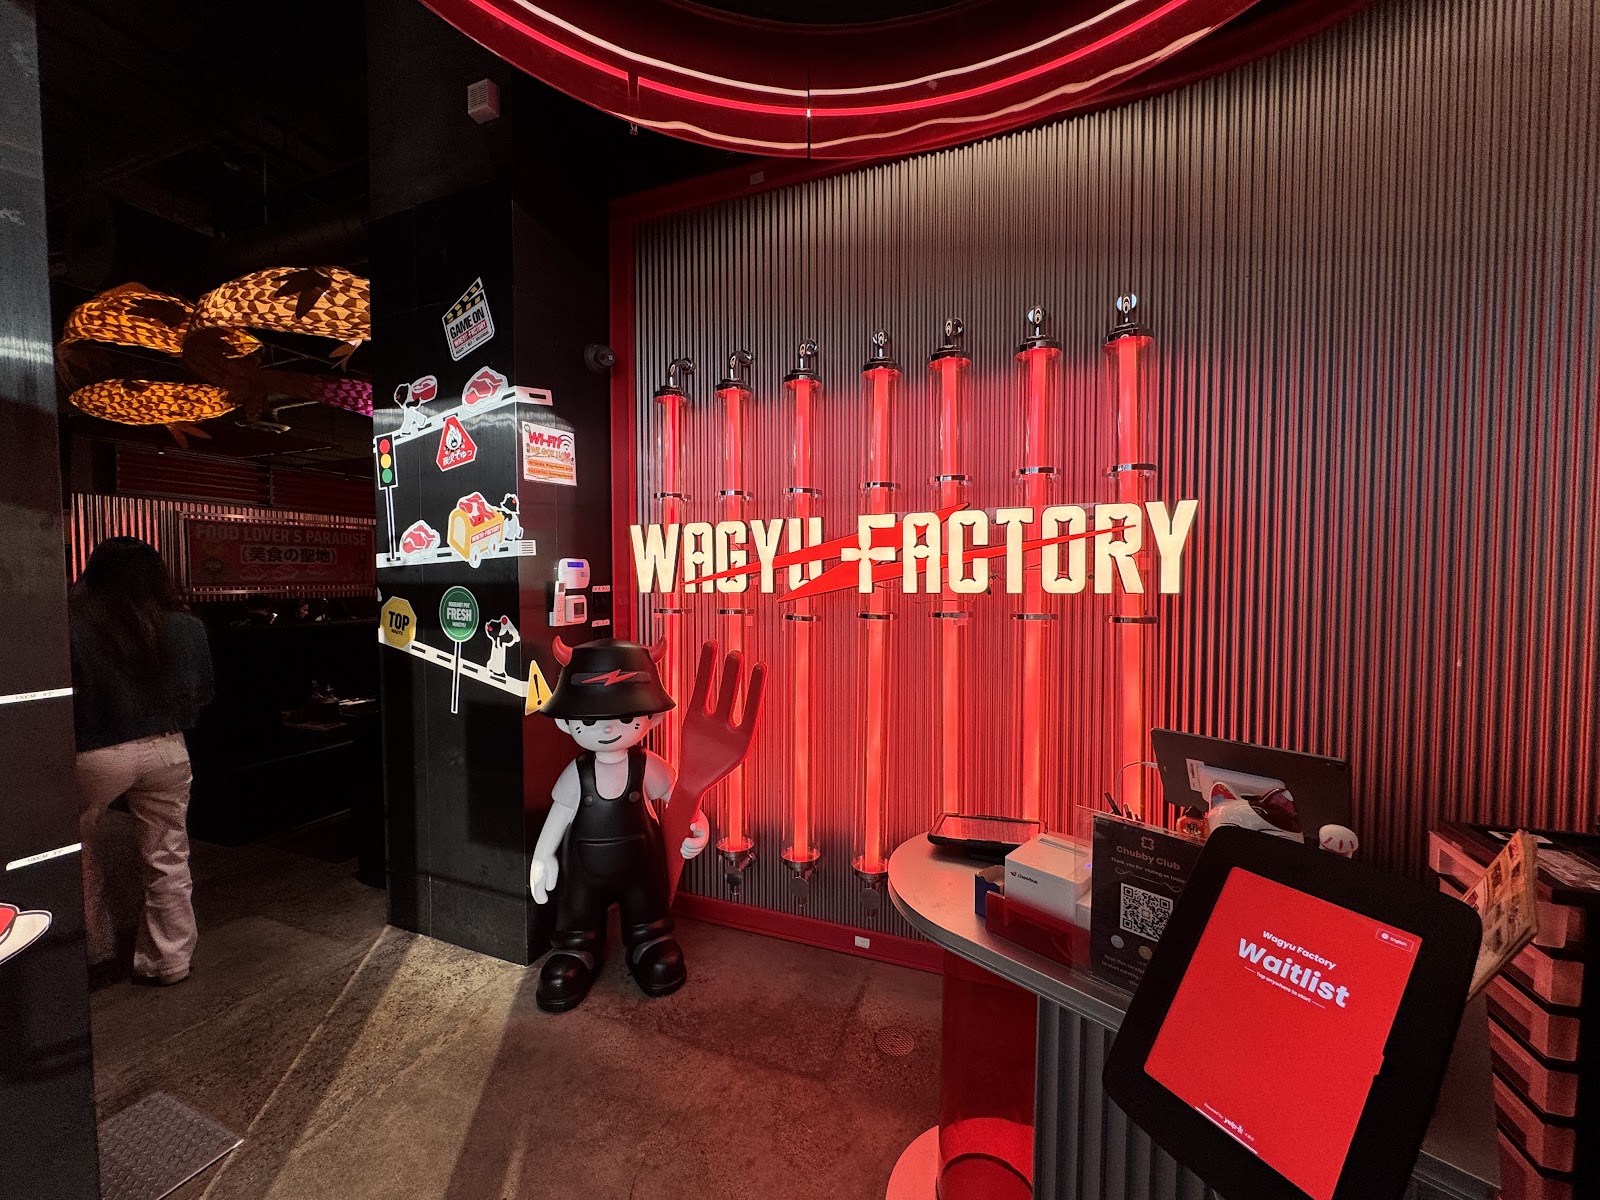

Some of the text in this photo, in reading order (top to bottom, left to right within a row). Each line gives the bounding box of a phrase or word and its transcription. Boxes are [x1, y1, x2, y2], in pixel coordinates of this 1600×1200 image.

[450, 306, 485, 339] GAME ON
[196, 524, 367, 546] FOOD LOVER'S PARADISE
[630, 500, 1199, 594] WAGYU FACTORY
[388, 610, 410, 632] TOP
[446, 607, 472, 622] FRESH
[1116, 845, 1181, 871] Chubby Club
[1262, 930, 1337, 971] Wagyu Factory
[1238, 937, 1350, 1009] Waitlist
[1266, 975, 1292, 993] anywhere
[1291, 988, 1298, 996] to
[1297, 991, 1312, 1003] start
[1223, 1117, 1238, 1130] yelp
